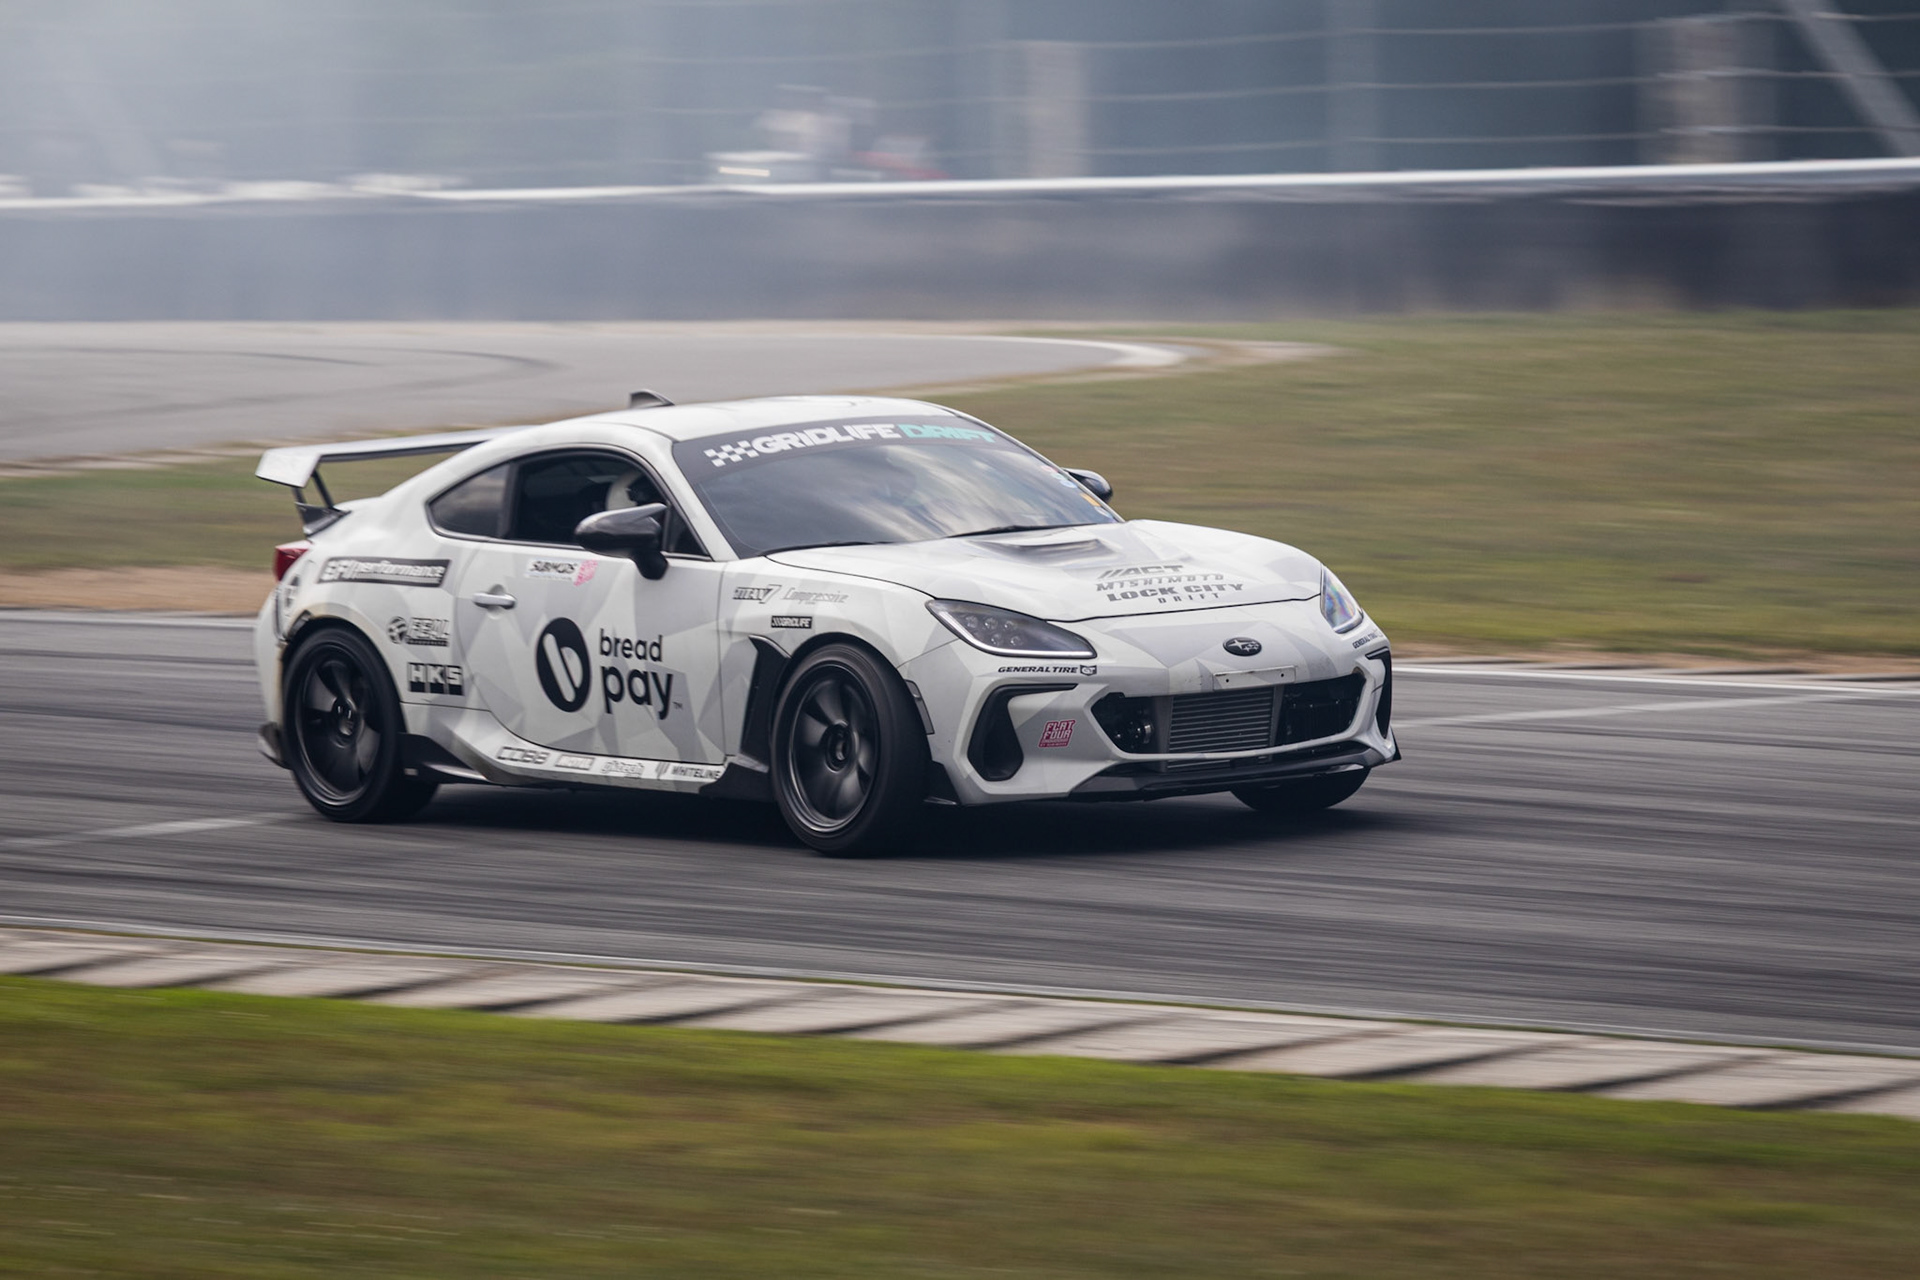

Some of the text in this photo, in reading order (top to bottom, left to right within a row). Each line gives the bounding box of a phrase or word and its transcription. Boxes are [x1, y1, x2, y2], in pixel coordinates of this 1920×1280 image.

[750, 423, 996, 454] GRIDLIFE DRIFT
[1096, 574, 1224, 592] MISHIMOTO
[1107, 583, 1244, 602] LOCK CITY
[1158, 593, 1220, 604] DRIFT
[600, 628, 663, 662] bread
[407, 662, 463, 690] HKS
[600, 665, 674, 720] pay
[1043, 730, 1071, 740] FOUR
[1046, 721, 1074, 731] FLAT
[672, 765, 721, 780] WHITELINE
